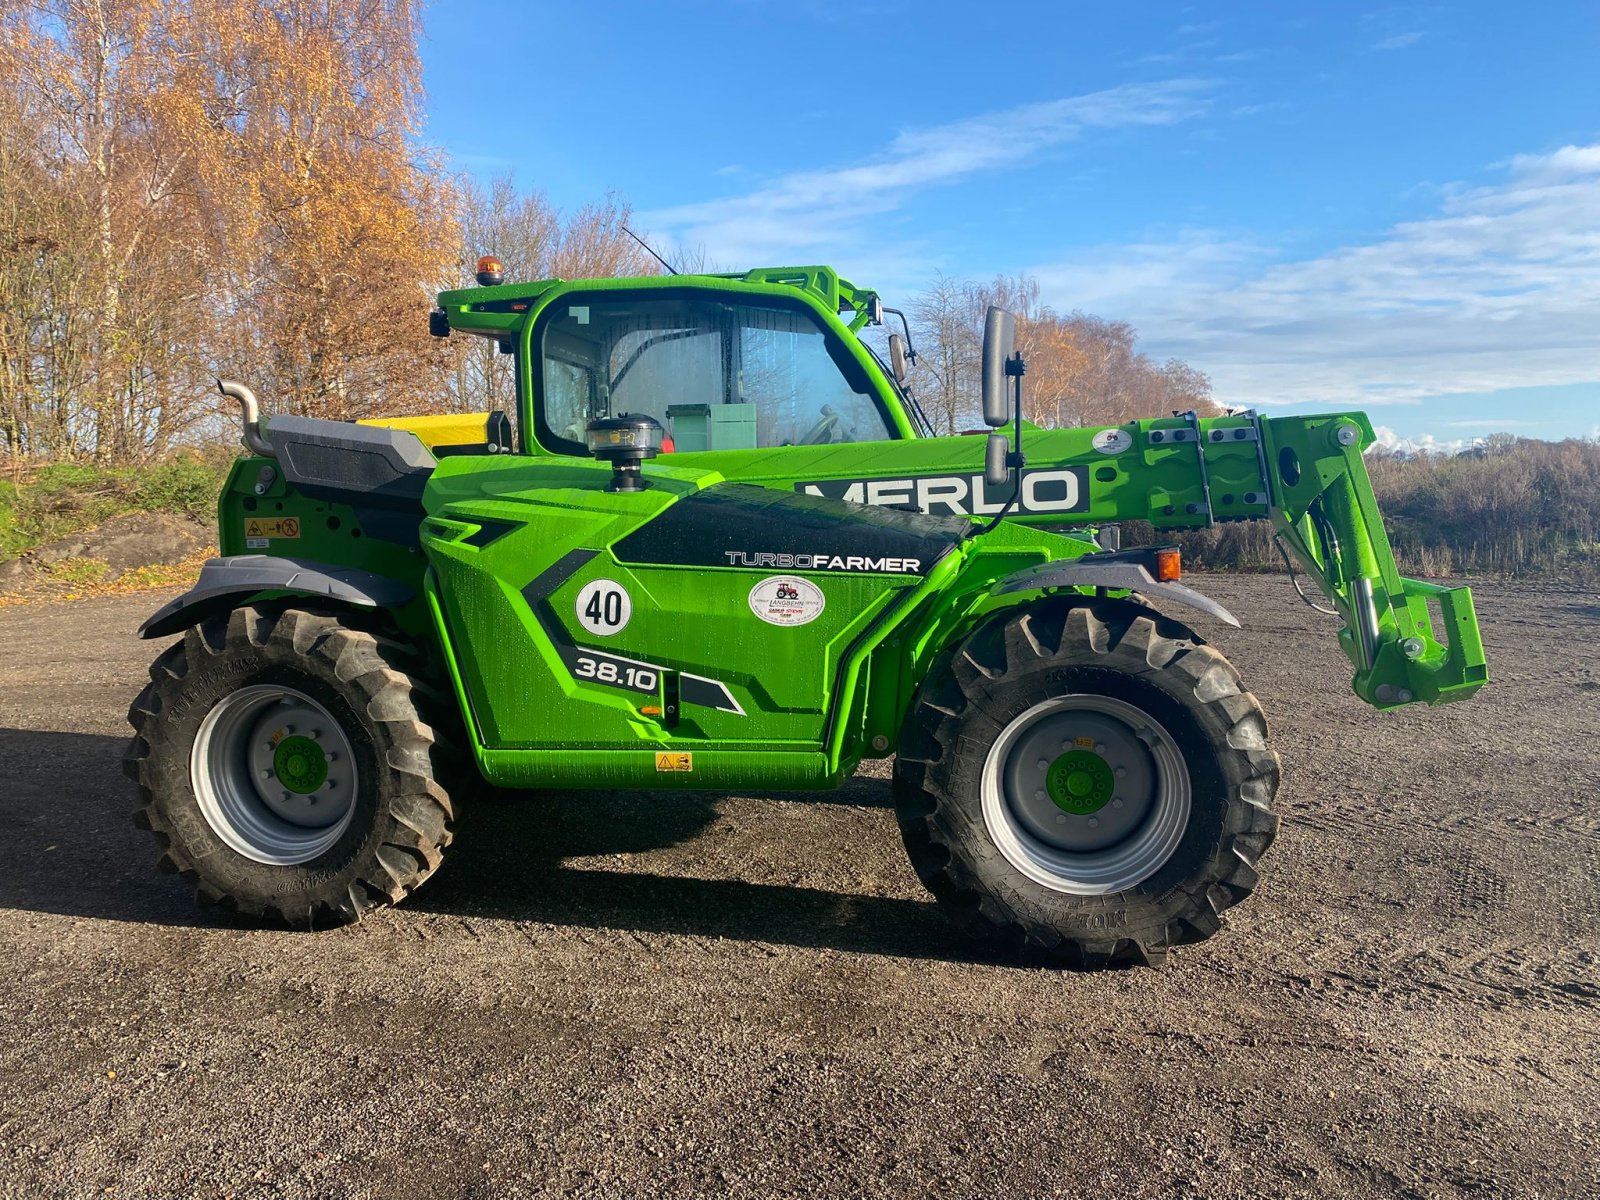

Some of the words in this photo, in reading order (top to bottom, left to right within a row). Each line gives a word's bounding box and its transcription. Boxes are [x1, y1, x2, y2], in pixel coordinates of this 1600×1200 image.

[725, 551, 921, 572] TURBOFARMER
[585, 590, 622, 626] 40
[575, 657, 657, 691] 38.10
